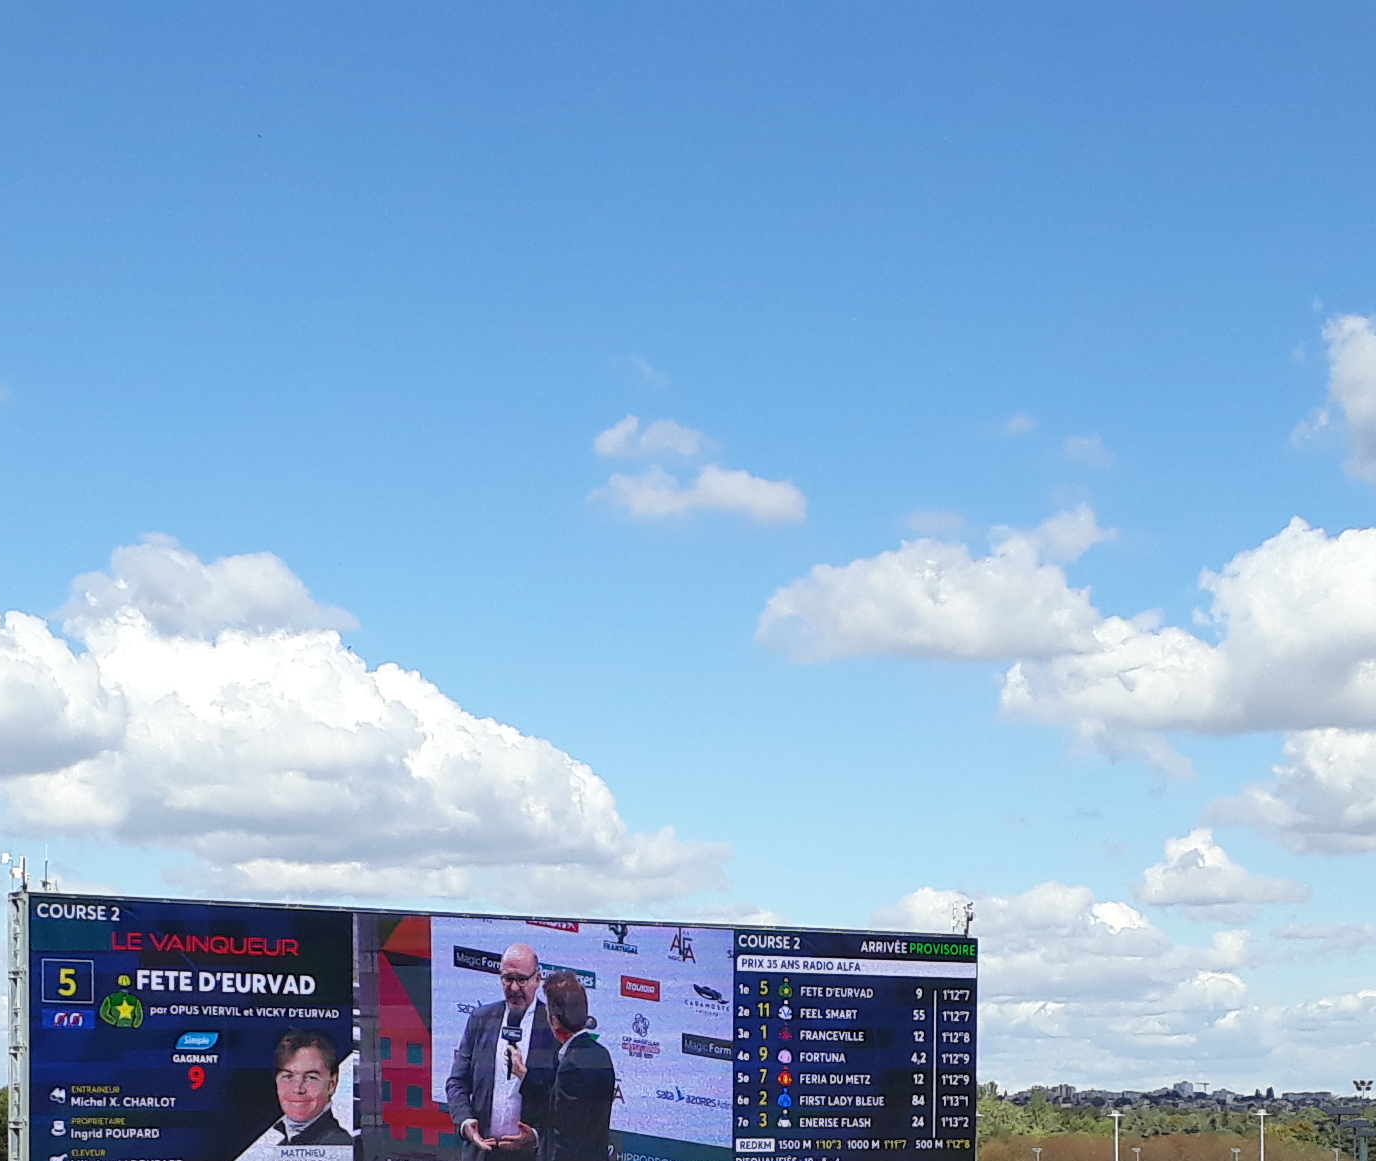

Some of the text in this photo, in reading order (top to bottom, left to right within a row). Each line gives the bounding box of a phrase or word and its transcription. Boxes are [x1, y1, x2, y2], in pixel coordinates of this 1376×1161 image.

[36, 903, 120, 921] COURSE 2
[111, 932, 300, 956] LE VAINQUEUR
[738, 935, 801, 949] COURSE 2
[860, 939, 976, 956] ARRIVÉE PROVISOIRE
[741, 959, 861, 971] PRIX 35 ANS RADIO ALFA
[58, 968, 77, 996] 5
[136, 970, 316, 995] FETE D'EURVAD
[759, 981, 768, 995] 5
[800, 987, 823, 997] FETE
[825, 987, 874, 998] D'EURVAD
[915, 988, 923, 999] 9
[150, 1005, 339, 1019] par OPUS VIERVIL et VICKY D'EURVAD
[757, 1003, 770, 1017] 11
[800, 1008, 823, 1019] FEEL
[825, 1009, 858, 1020] SMART
[913, 1009, 926, 1020] 55
[183, 1034, 210, 1047] Simple
[760, 1024, 767, 1039] 1
[800, 1030, 865, 1042] FRANCEVILLE
[913, 1031, 925, 1042] 12
[173, 1054, 219, 1063] GAGNANT
[759, 1047, 768, 1062] 9
[799, 1052, 846, 1063] FORTUNA
[911, 1052, 927, 1065] 4,2
[187, 1066, 206, 1089] 9
[759, 1069, 768, 1083] 7
[799, 1074, 828, 1085] FERIA
[830, 1074, 843, 1085] DU
[846, 1074, 871, 1085] METZ
[913, 1074, 924, 1085] 12
[71, 1097, 176, 1108] Michel X. CHARLOT
[759, 1091, 768, 1106] 2
[799, 1096, 826, 1106] FIRST
[828, 1096, 854, 1107] LADY
[855, 1096, 885, 1107] BLEUE
[911, 1095, 925, 1106] 84
[759, 1112, 768, 1127] 3
[799, 1117, 839, 1128] ENERISE
[841, 1118, 871, 1128] FLASH
[911, 1117, 925, 1127] 24
[71, 1128, 160, 1140] Ingrid POUPARD
[281, 1149, 325, 1157] MATTHIEU
[778, 1140, 800, 1150] 1500
[803, 1140, 812, 1150] M
[847, 1140, 869, 1150] 1000
[872, 1140, 880, 1150] M
[915, 1140, 933, 1149] 500
[935, 1140, 943, 1150] M
